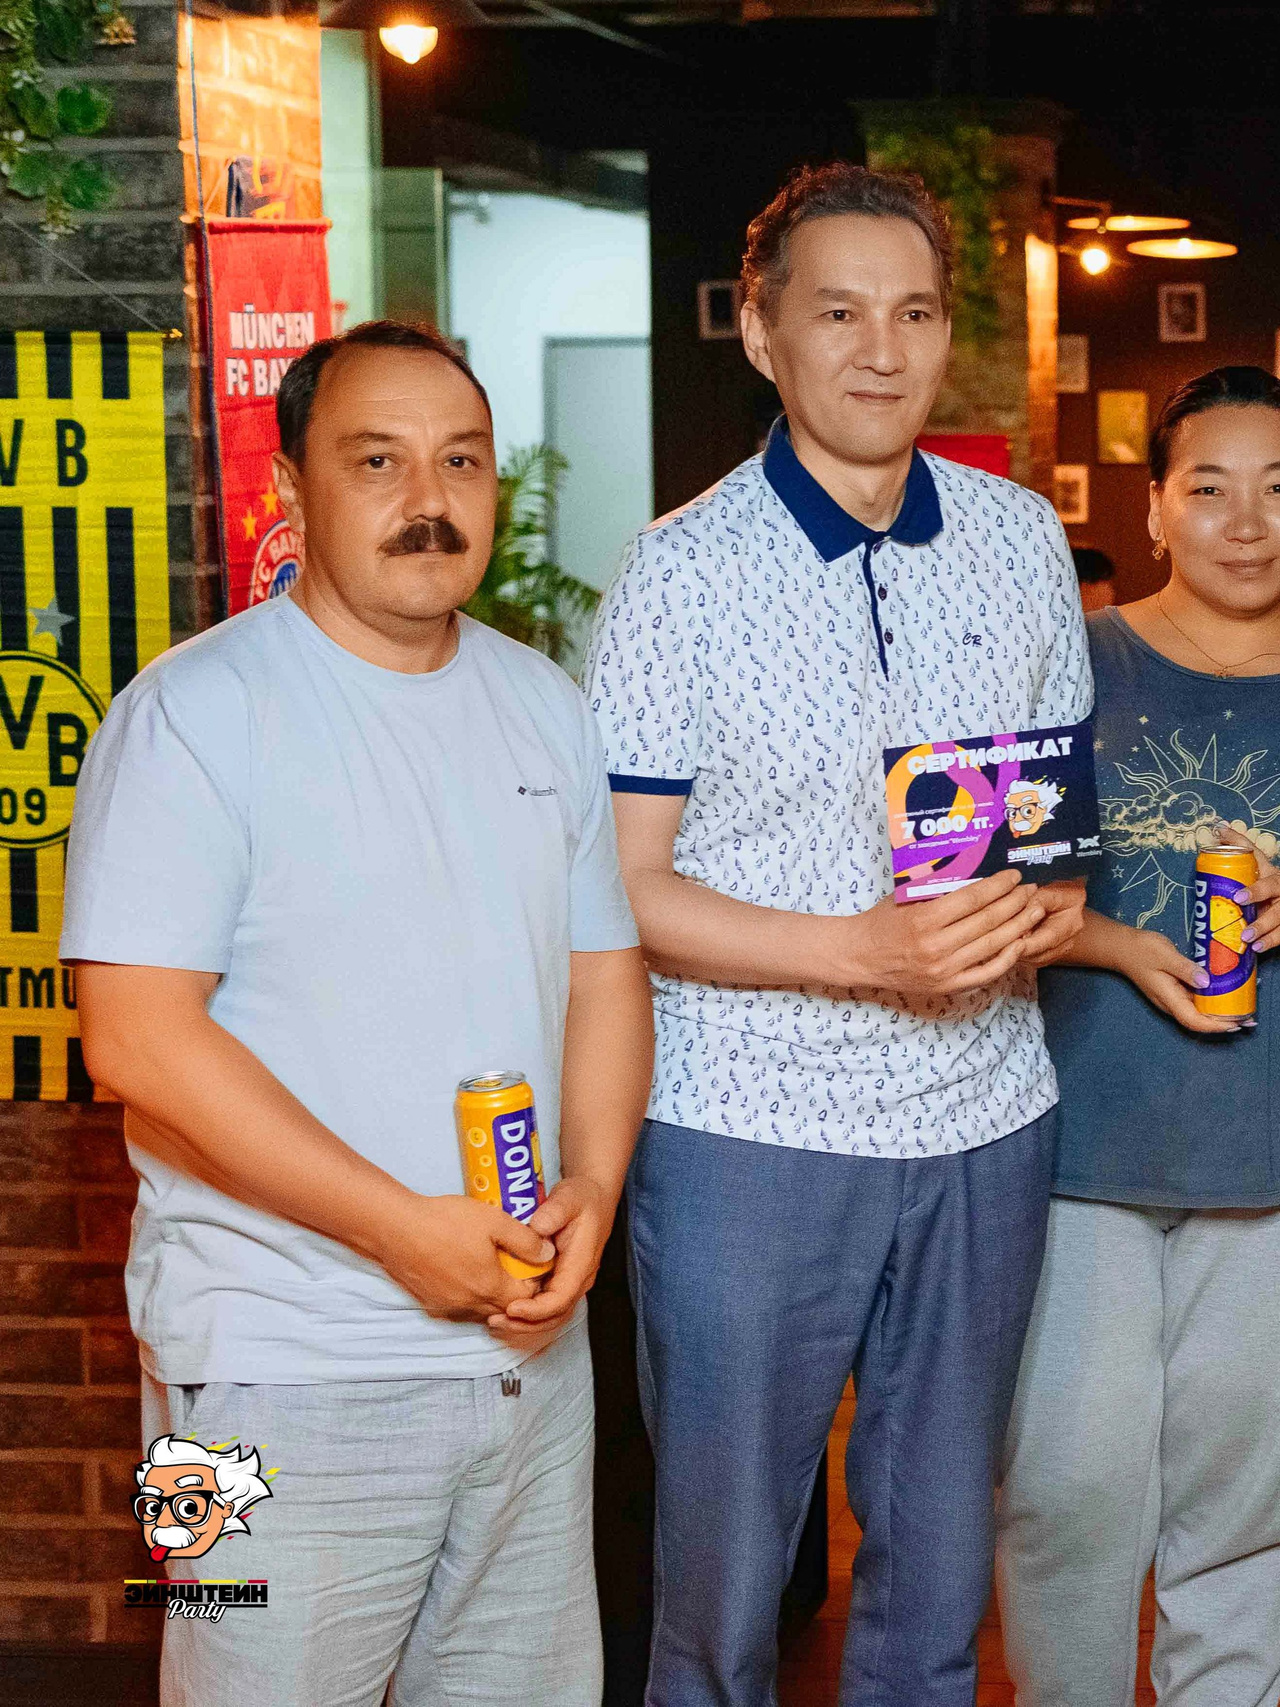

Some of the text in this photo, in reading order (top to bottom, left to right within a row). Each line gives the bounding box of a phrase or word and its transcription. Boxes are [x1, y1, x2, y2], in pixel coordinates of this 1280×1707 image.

[229, 303, 315, 349] MÜNCHEN
[226, 357, 249, 396] FC
[907, 737, 1073, 775] СЕРТИФИКАТ
[901, 820, 916, 839] 7
[920, 814, 968, 837] 000
